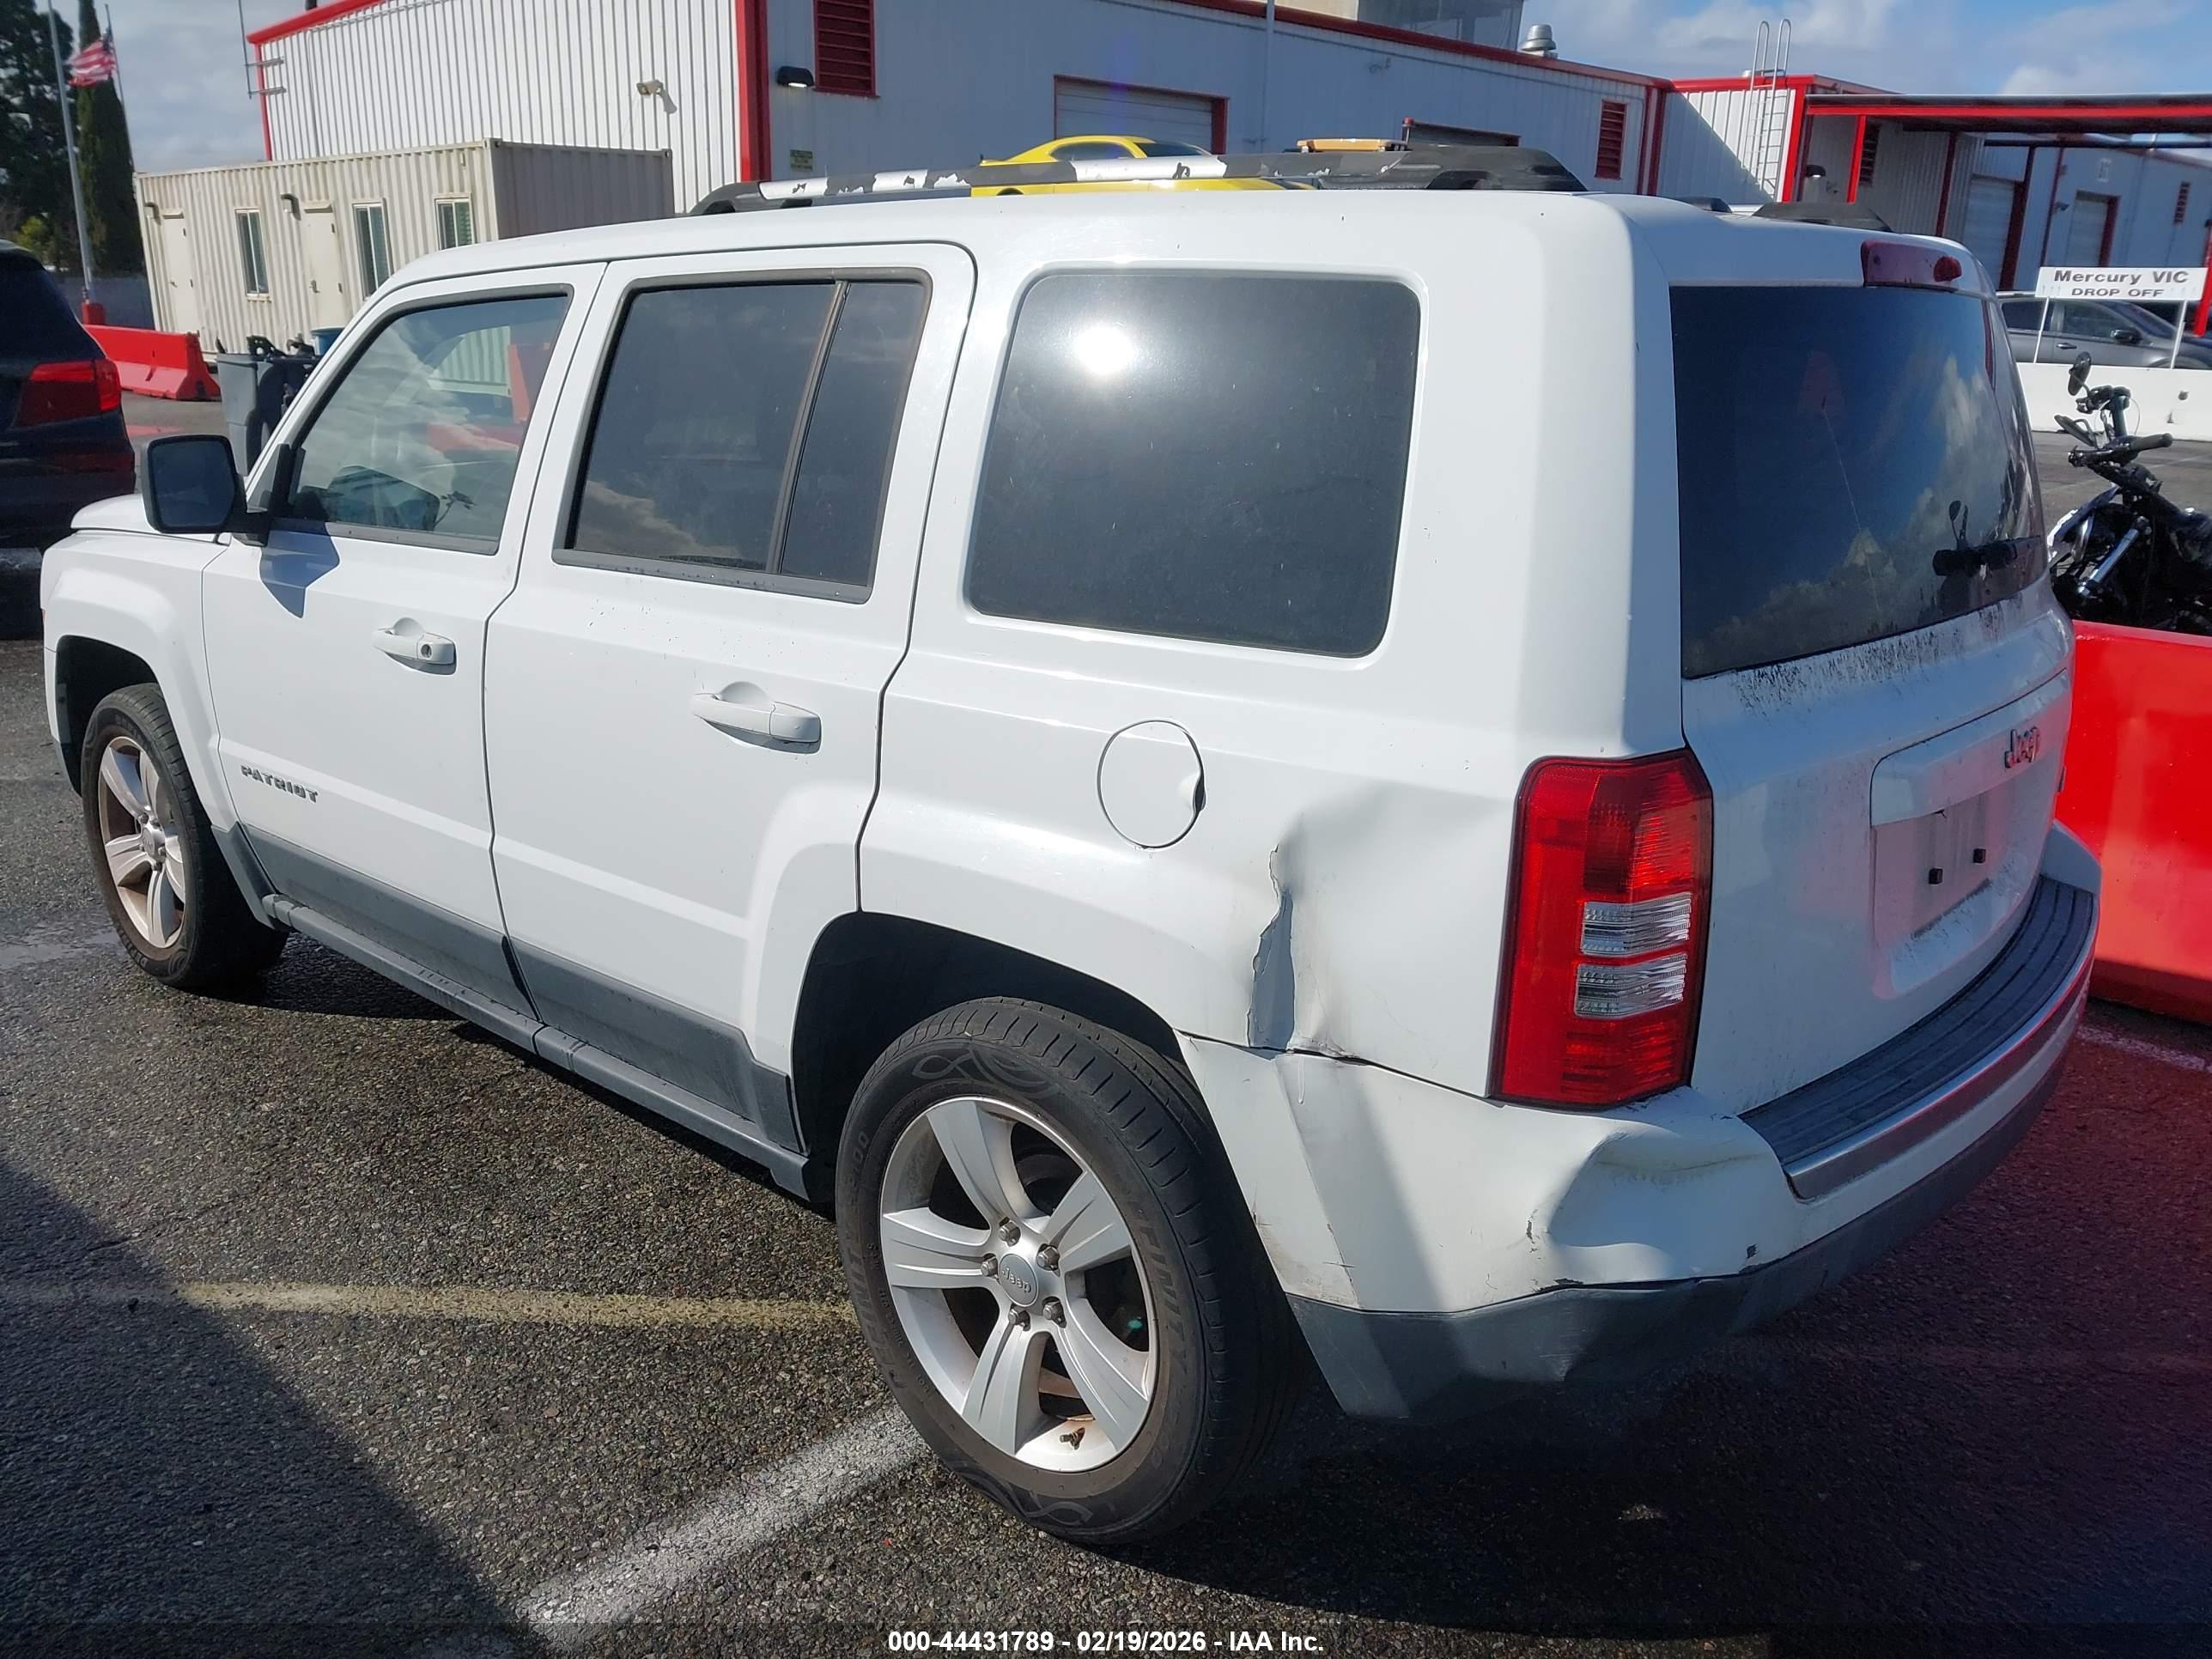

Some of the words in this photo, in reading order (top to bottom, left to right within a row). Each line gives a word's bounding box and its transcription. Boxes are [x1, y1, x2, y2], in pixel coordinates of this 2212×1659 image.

[2053, 270, 2142, 285] Mercury
[2152, 270, 2190, 283] VIC
[2070, 288, 2120, 297] DROP
[2128, 289, 2165, 298] OFF
[240, 764, 319, 804] PATRIOT
[1001, 1267, 1033, 1294] Jeep
